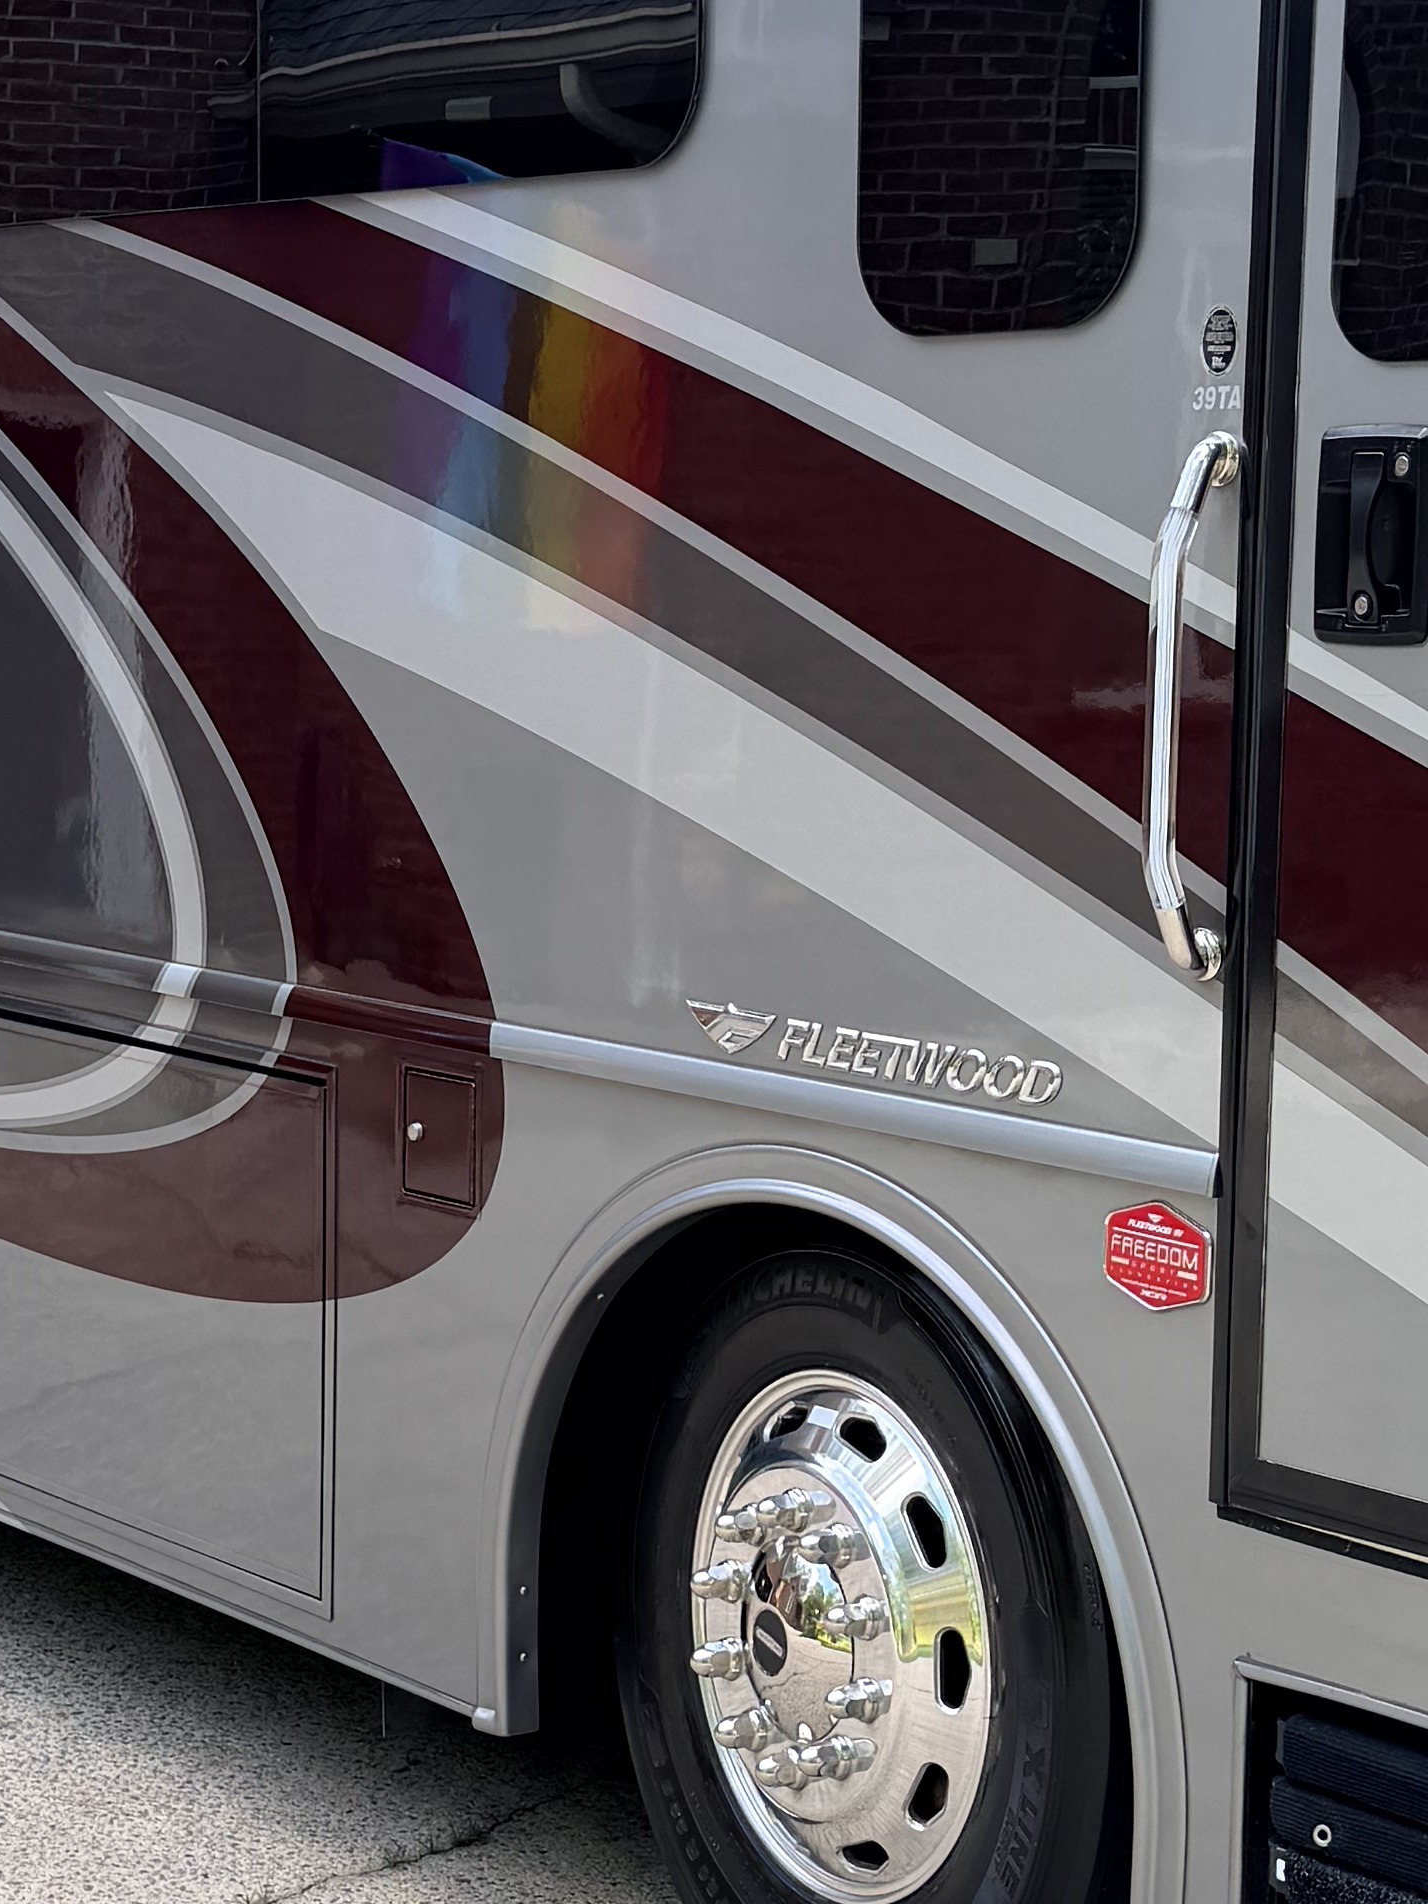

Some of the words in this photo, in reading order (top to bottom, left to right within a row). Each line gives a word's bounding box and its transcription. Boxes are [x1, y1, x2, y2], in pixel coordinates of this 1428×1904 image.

[1192, 384, 1242, 411] 39TA
[776, 1018, 1064, 1106] FLEETWOOD
[1110, 1233, 1199, 1271] FREEDOM
